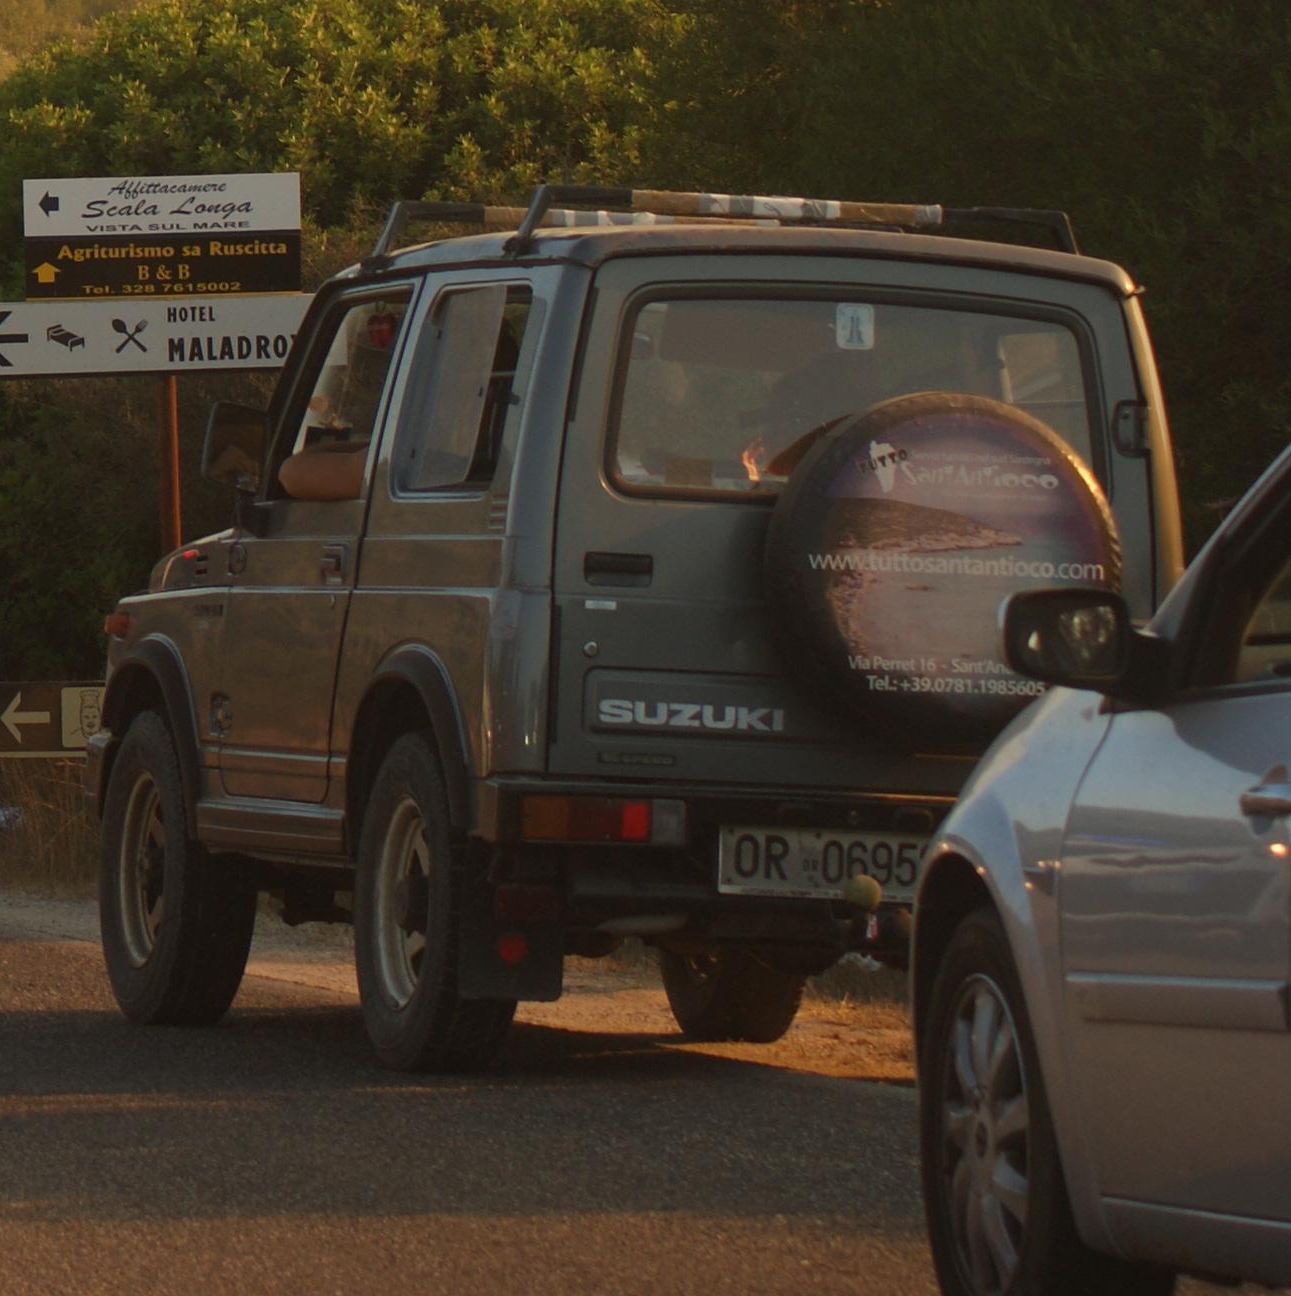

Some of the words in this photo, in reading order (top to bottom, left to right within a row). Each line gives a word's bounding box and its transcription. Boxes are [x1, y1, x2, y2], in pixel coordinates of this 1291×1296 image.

[108, 180, 226, 199] Affittacamere
[81, 200, 161, 218] Scala
[170, 197, 253, 219] Longa
[86, 224, 143, 232] VISTA
[148, 223, 186, 231] SUL
[193, 221, 250, 230] MARE
[57, 244, 175, 262] Agriturismo
[182, 245, 201, 257] sa
[210, 240, 287, 257] Ruscitta
[138, 265, 150, 280] B
[156, 265, 172, 280] &
[179, 264, 191, 279] B
[83, 285, 113, 294] Tel.
[122, 284, 156, 293] 328
[163, 282, 241, 292] 7615002
[167, 306, 216, 322] HOTEL
[168, 335, 297, 362] MALADRO
[809, 553, 1105, 580] www.tuttosantantioco.com
[848, 656, 871, 669] Via
[920, 657, 937, 671] 16
[951, 658, 1013, 674] Sant'An
[599, 699, 785, 731] SUZUKI
[734, 833, 789, 880] OR
[822, 840, 928, 886] 0695
